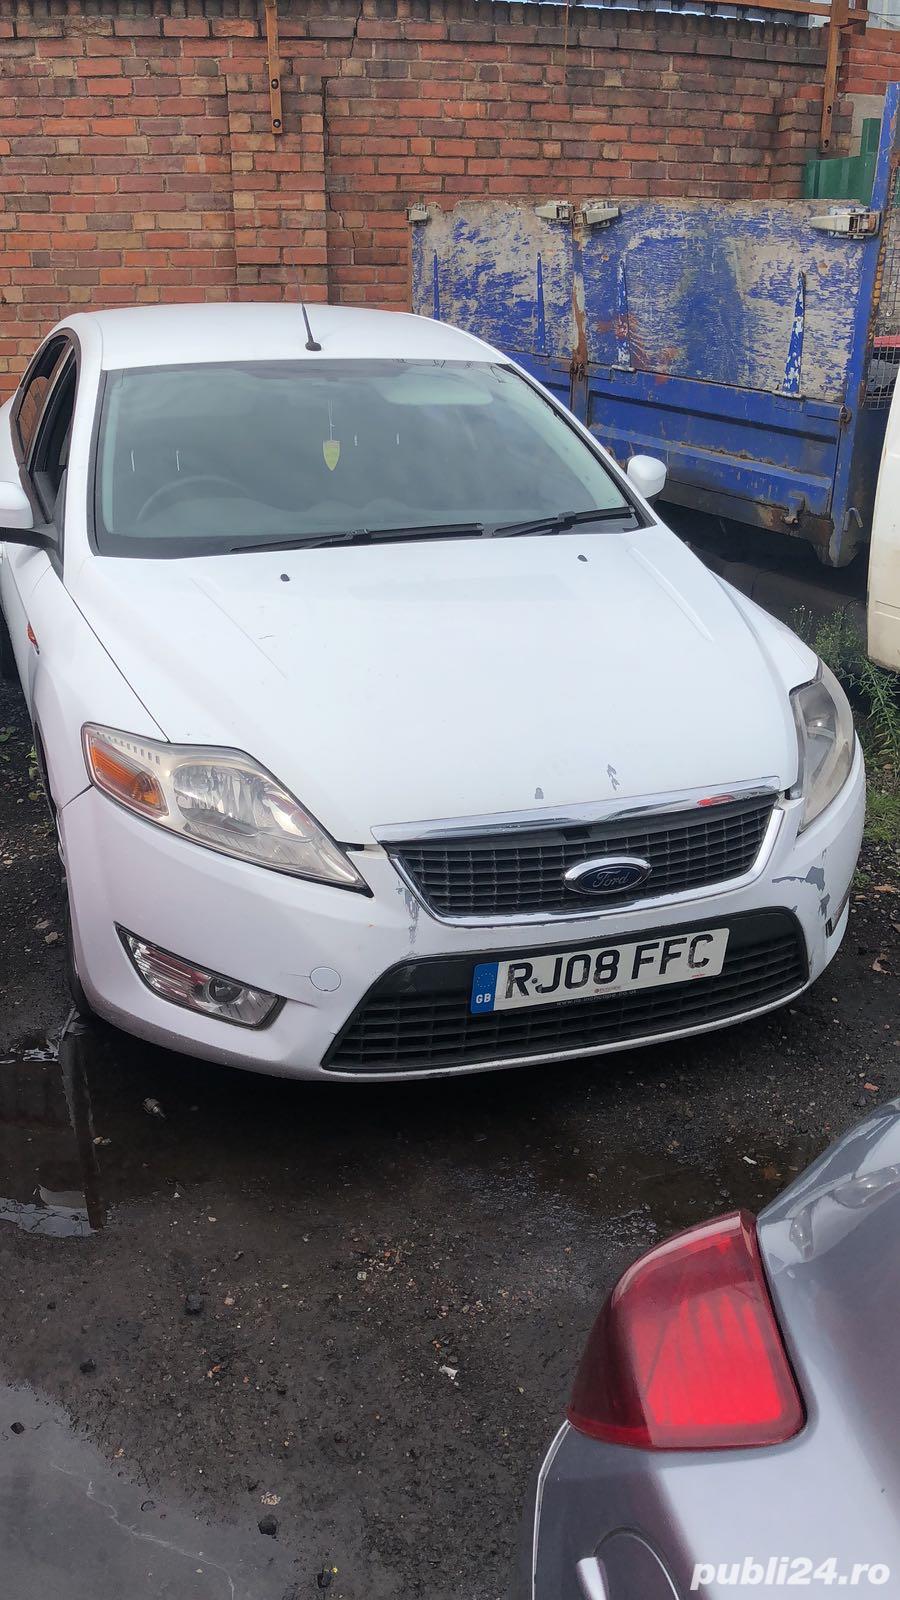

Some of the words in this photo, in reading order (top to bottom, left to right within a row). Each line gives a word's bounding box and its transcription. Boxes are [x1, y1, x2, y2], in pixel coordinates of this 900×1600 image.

[593, 870, 630, 888] Ford
[505, 949, 620, 999] RJ08
[631, 934, 714, 980] FFC
[476, 993, 491, 1004] GB
